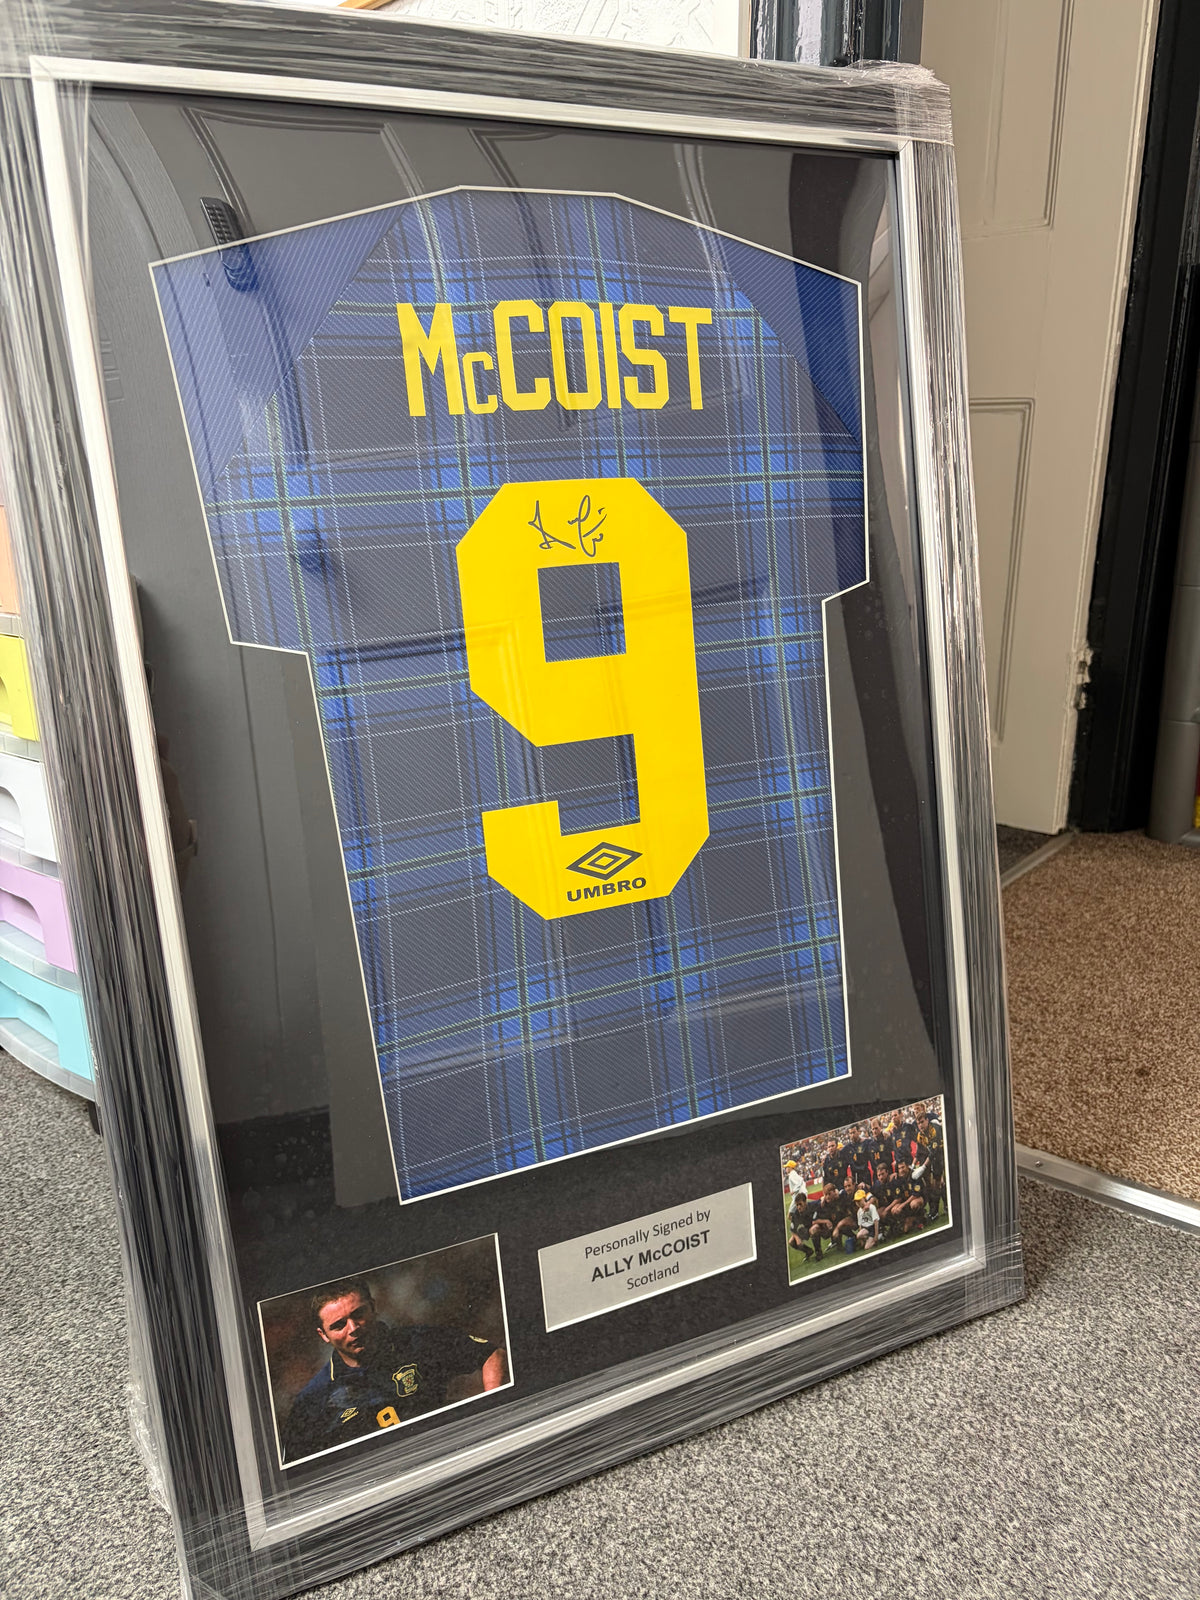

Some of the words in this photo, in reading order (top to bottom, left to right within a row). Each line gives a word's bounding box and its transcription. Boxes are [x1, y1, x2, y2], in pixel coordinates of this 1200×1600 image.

[396, 299, 713, 417] McCOIST
[455, 477, 710, 920] 9
[566, 877, 647, 902] UMBRO
[584, 1229, 650, 1259] Personally
[652, 1212, 693, 1237] Signed
[696, 1209, 711, 1223] by
[591, 1254, 634, 1283] ALLY
[638, 1229, 711, 1266] McCOIST
[626, 1261, 680, 1290] Scotland
